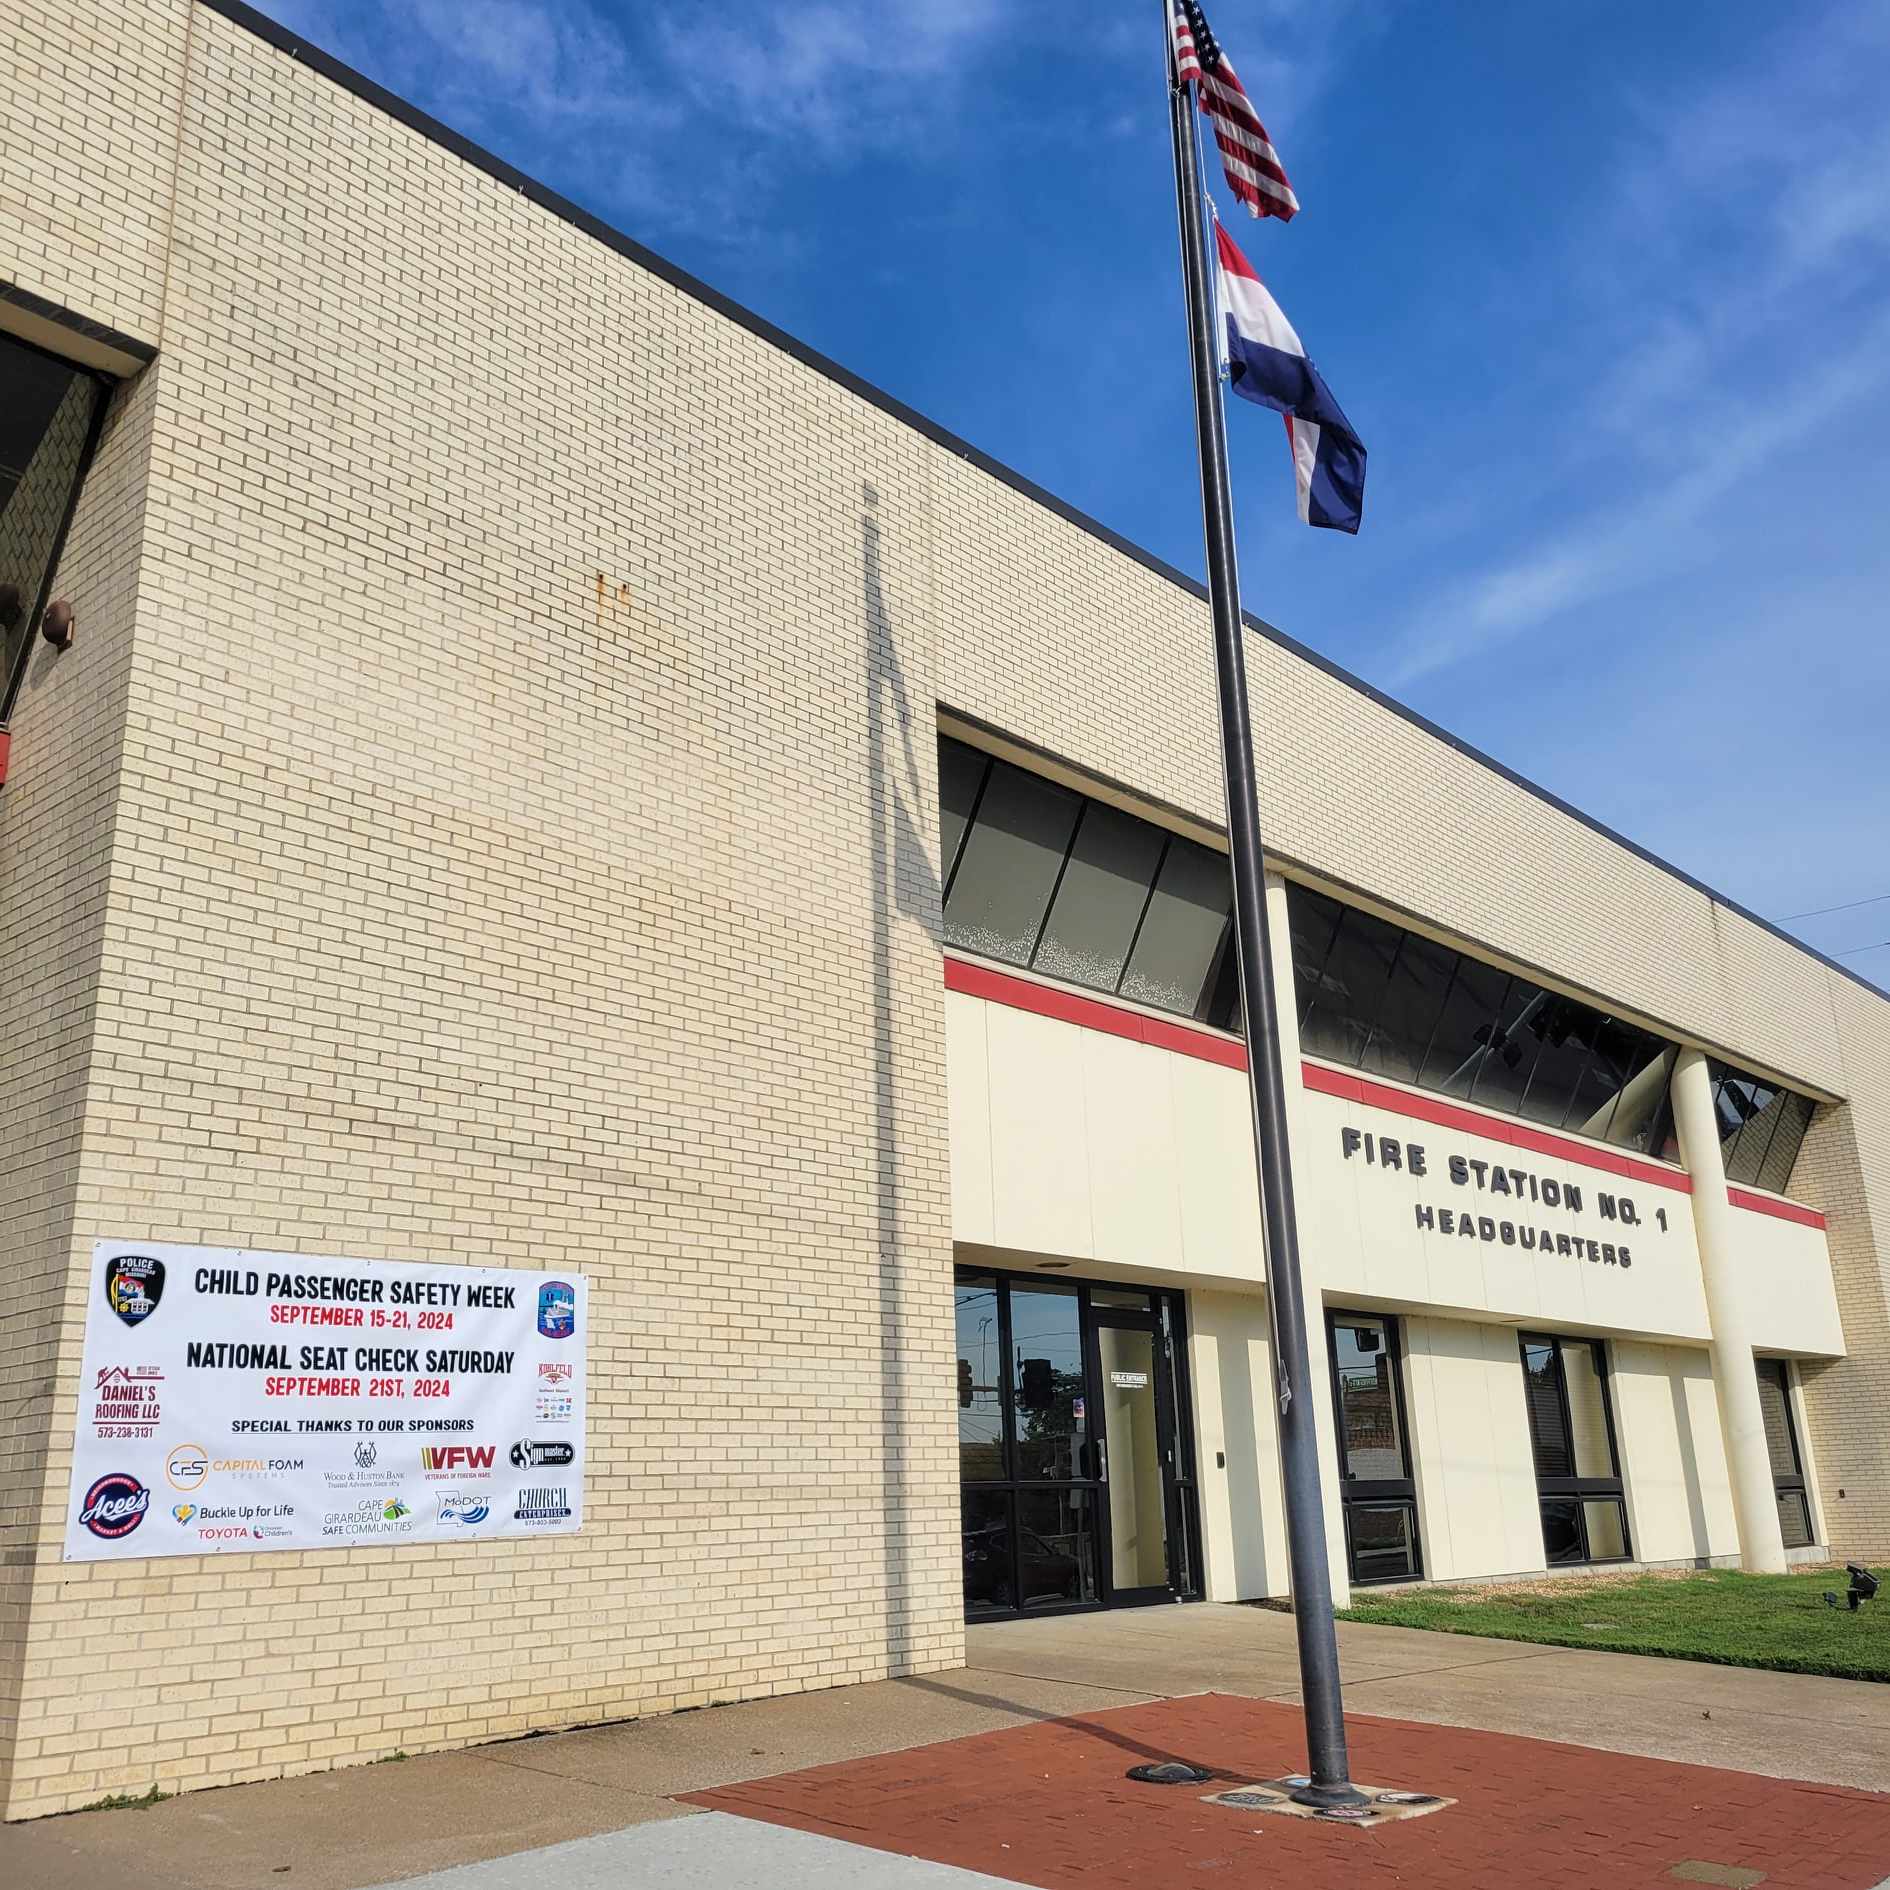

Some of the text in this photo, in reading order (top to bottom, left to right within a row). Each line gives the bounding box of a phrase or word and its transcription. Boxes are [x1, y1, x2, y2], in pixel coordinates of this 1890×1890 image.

[1341, 1126, 1668, 1233] FIRE STATION NO. 1
[1415, 1204, 1632, 1269] HEADQUARTERS
[120, 1258, 155, 1269] POLICE
[195, 1268, 516, 1309] CHILD PASSENGER SAFETY WEEK
[270, 1304, 454, 1330] SEPTEMBER 15-21, 2024
[187, 1342, 515, 1374] NATIONAL SEAT CHECK SATURDAY
[102, 1385, 156, 1401] DANIEL'S
[265, 1377, 450, 1399] SEPTEMBER 21ST, 2024
[95, 1403, 161, 1419] ROOFING LLC
[97, 1426, 153, 1439] 573-238-3131
[232, 1418, 475, 1432] SPECIAL THANKS TO OUR SPONSORS
[431, 1446, 496, 1469] VFW
[169, 1460, 208, 1475] CFS
[212, 1460, 304, 1471] CAPITAL FOAM
[347, 1471, 355, 1480] &
[358, 1499, 384, 1511] CAPE
[444, 1496, 492, 1507] MoDOT
[518, 1487, 567, 1509] CHURCH
[199, 1504, 295, 1520] Buckle Up for Life
[324, 1511, 382, 1525] GIRARDEAU
[198, 1527, 248, 1540] TOYOTA
[321, 1521, 413, 1536] SAFE COMMUNITIES
